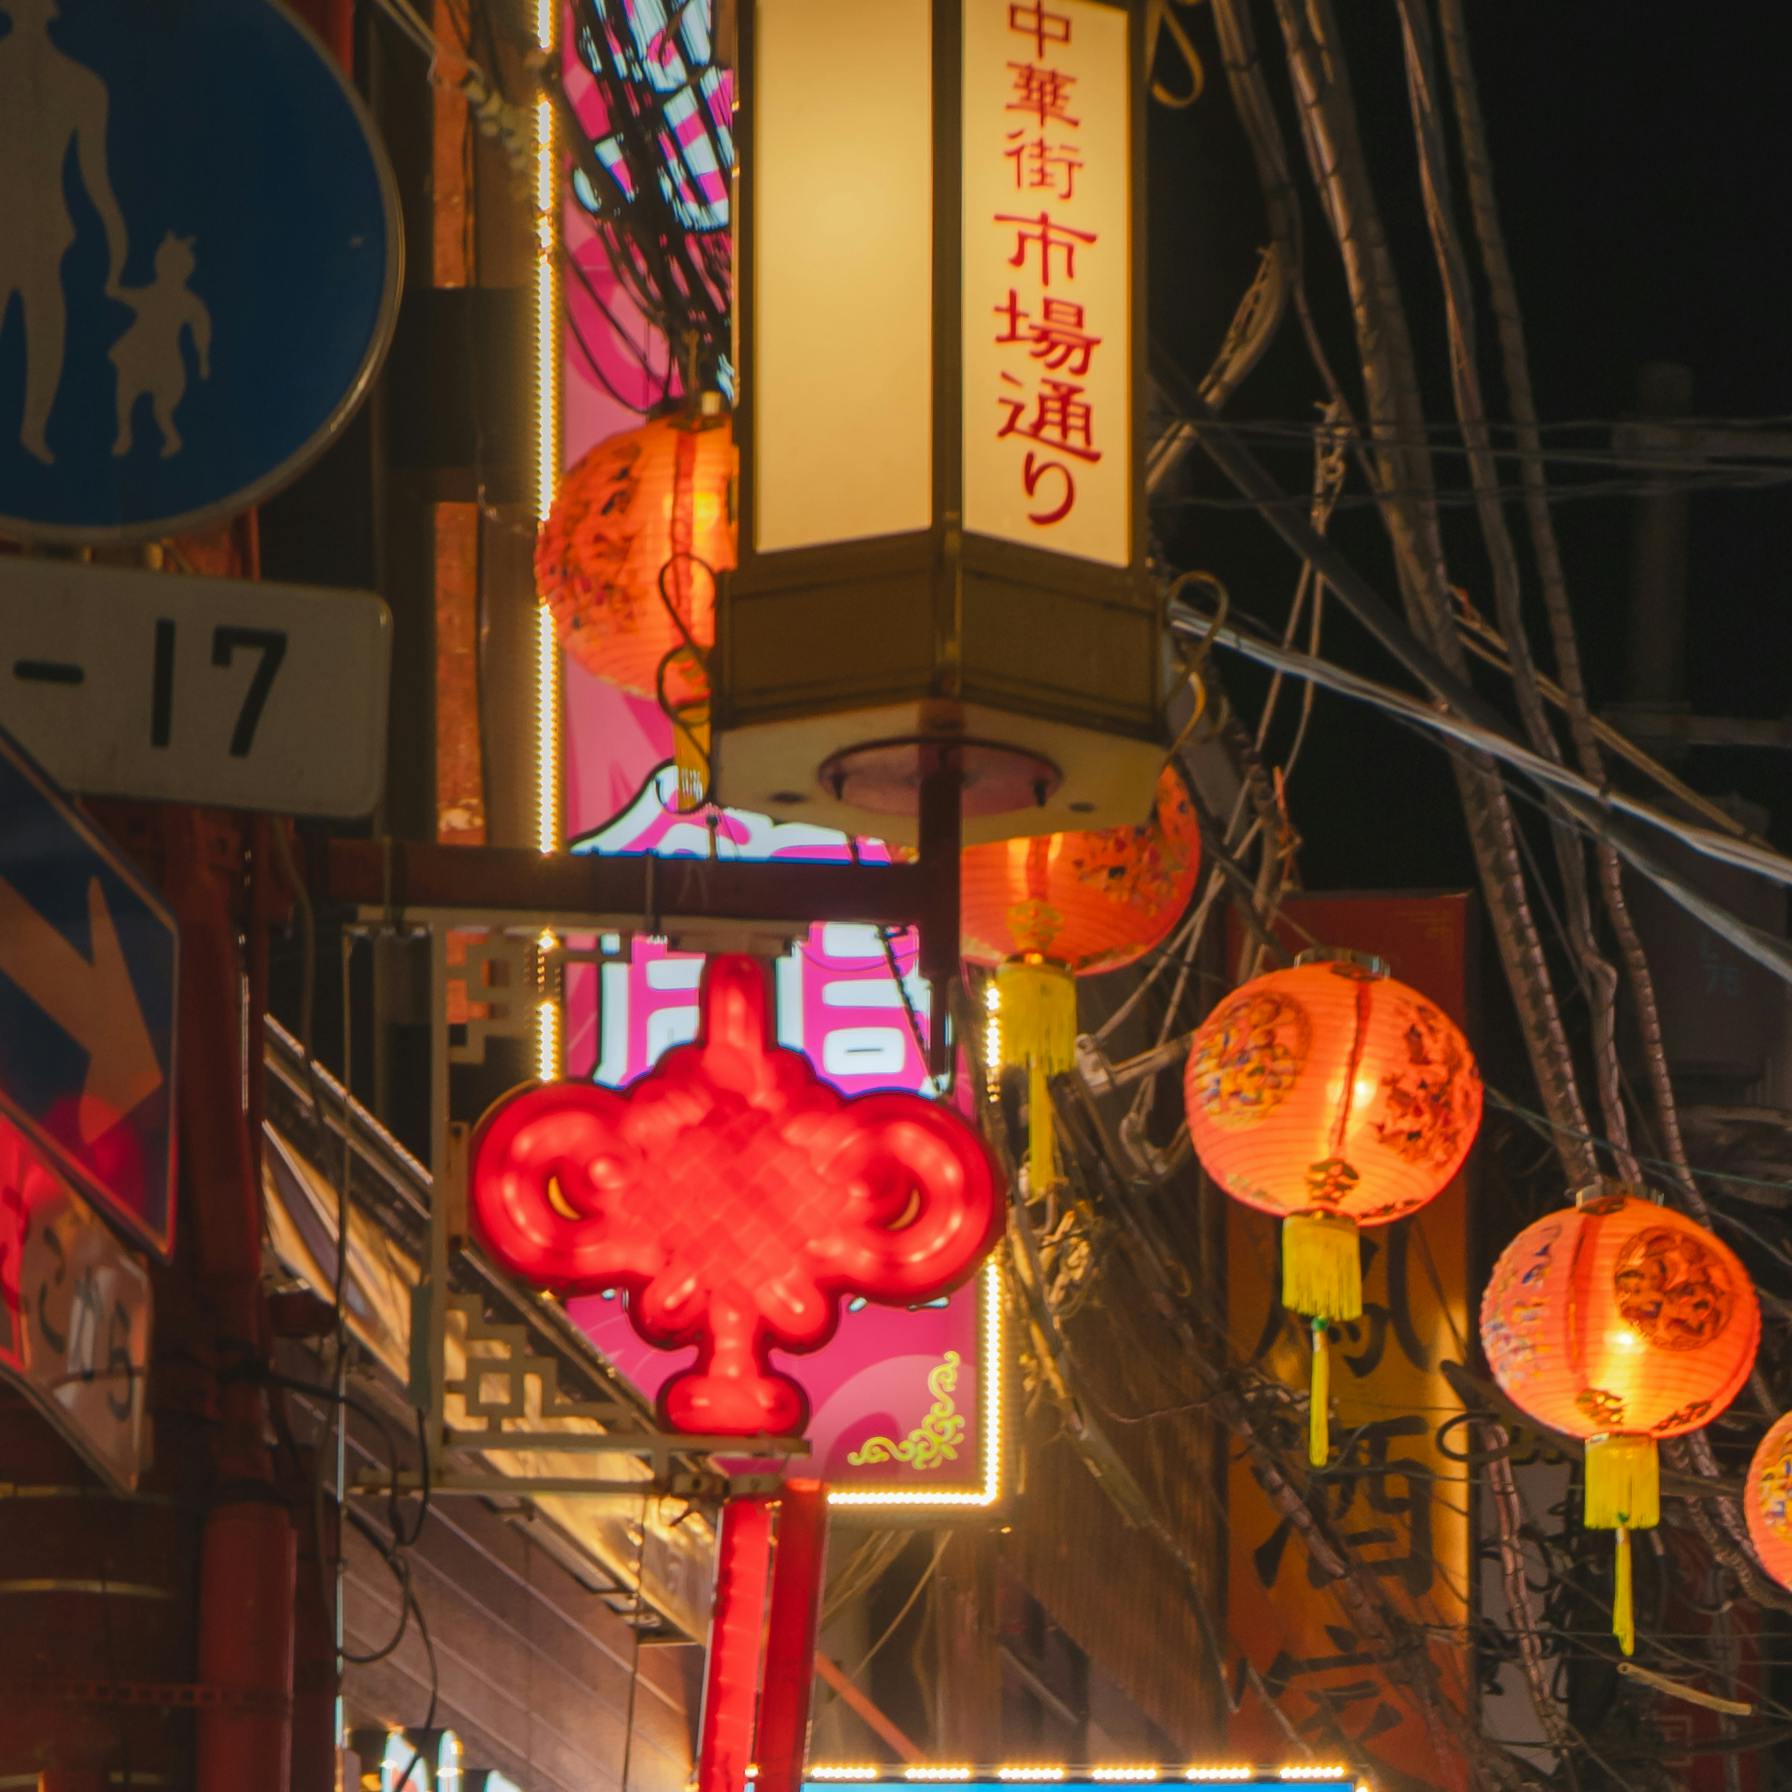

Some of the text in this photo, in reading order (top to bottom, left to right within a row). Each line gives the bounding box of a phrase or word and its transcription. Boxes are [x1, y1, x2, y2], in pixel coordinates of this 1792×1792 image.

[994, 0, 1104, 526] 中華街市場通り
